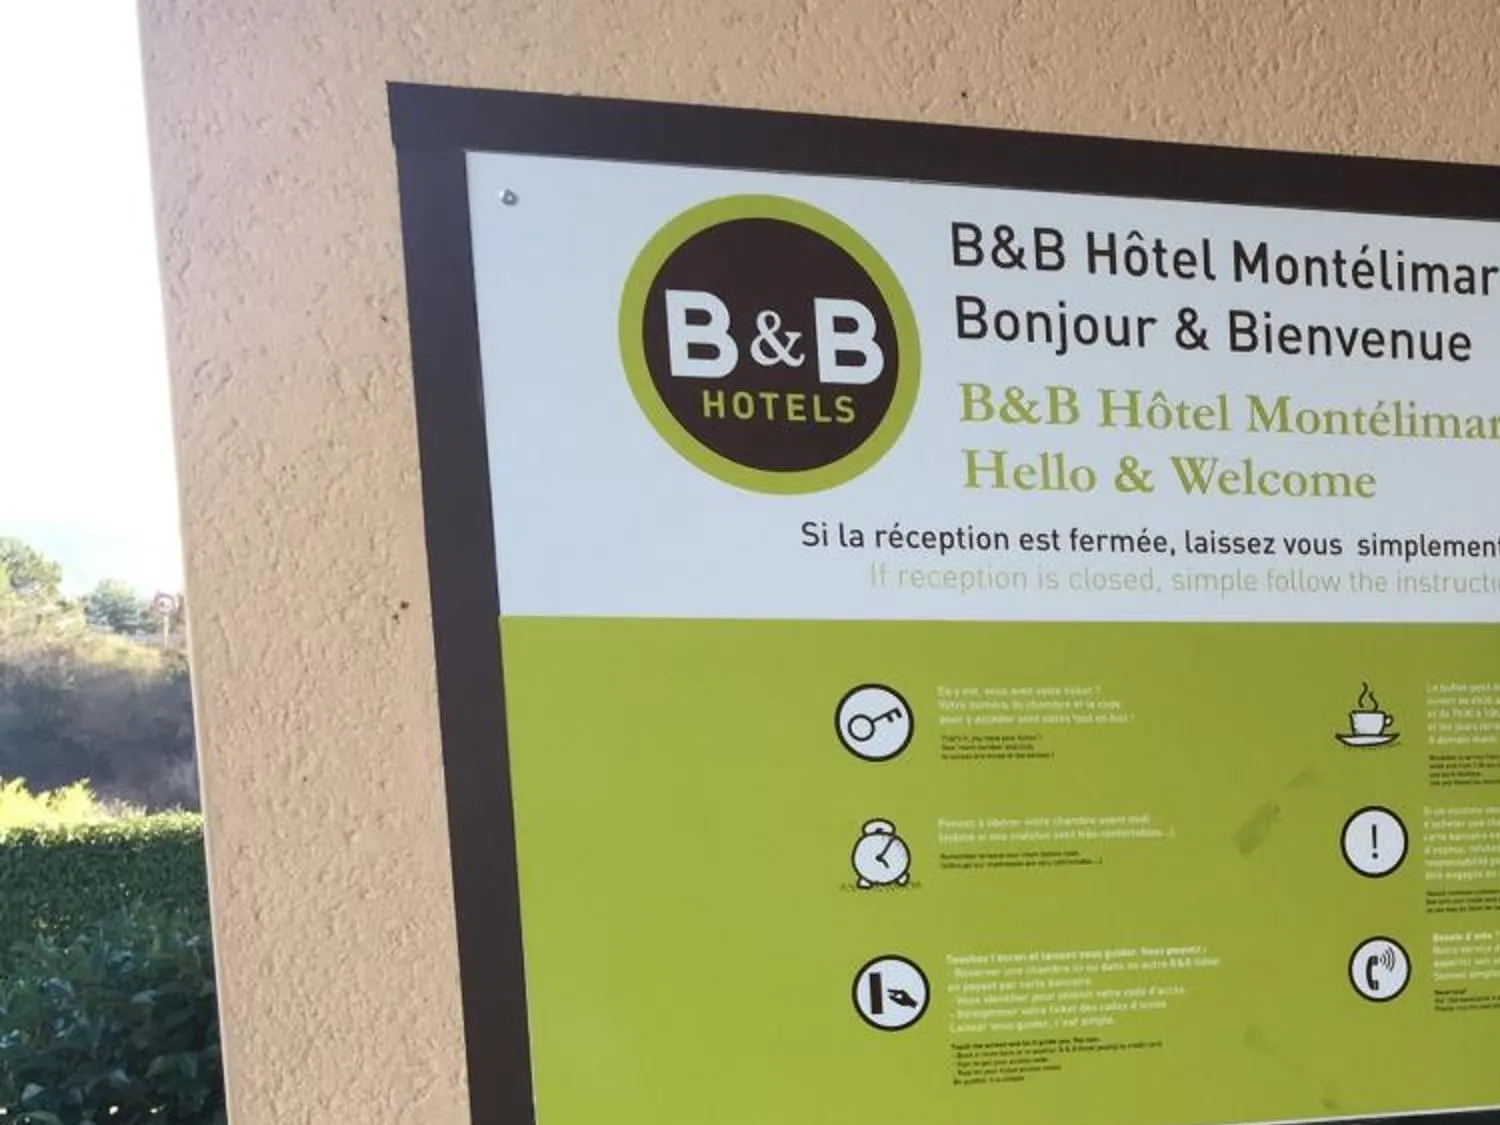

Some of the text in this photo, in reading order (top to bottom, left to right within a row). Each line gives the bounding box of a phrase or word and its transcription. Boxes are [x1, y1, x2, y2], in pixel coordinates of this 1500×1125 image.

[951, 221, 1500, 298] B&B Hôtel Montélimar
[955, 295, 1473, 363] Bonjour & Bienvenue
[702, 389, 857, 425] HOTELS
[959, 381, 1081, 427] B&B
[1098, 387, 1230, 433] Hôtel
[960, 448, 1377, 500] Hello & Welcome
[801, 521, 829, 549] Si
[839, 523, 865, 551] la
[876, 524, 1010, 558] réception
[1019, 529, 1062, 553] est
[1069, 526, 1177, 559] fermée,
[1184, 529, 1276, 557] laissez
[1283, 537, 1343, 557] vous
[870, 562, 887, 587] If
[898, 564, 1028, 597] reception
[1036, 567, 1060, 592] is
[1069, 567, 1163, 597] closed,
[1171, 567, 1258, 600] simple
[1265, 567, 1342, 593] follow
[1349, 568, 1389, 593] the
